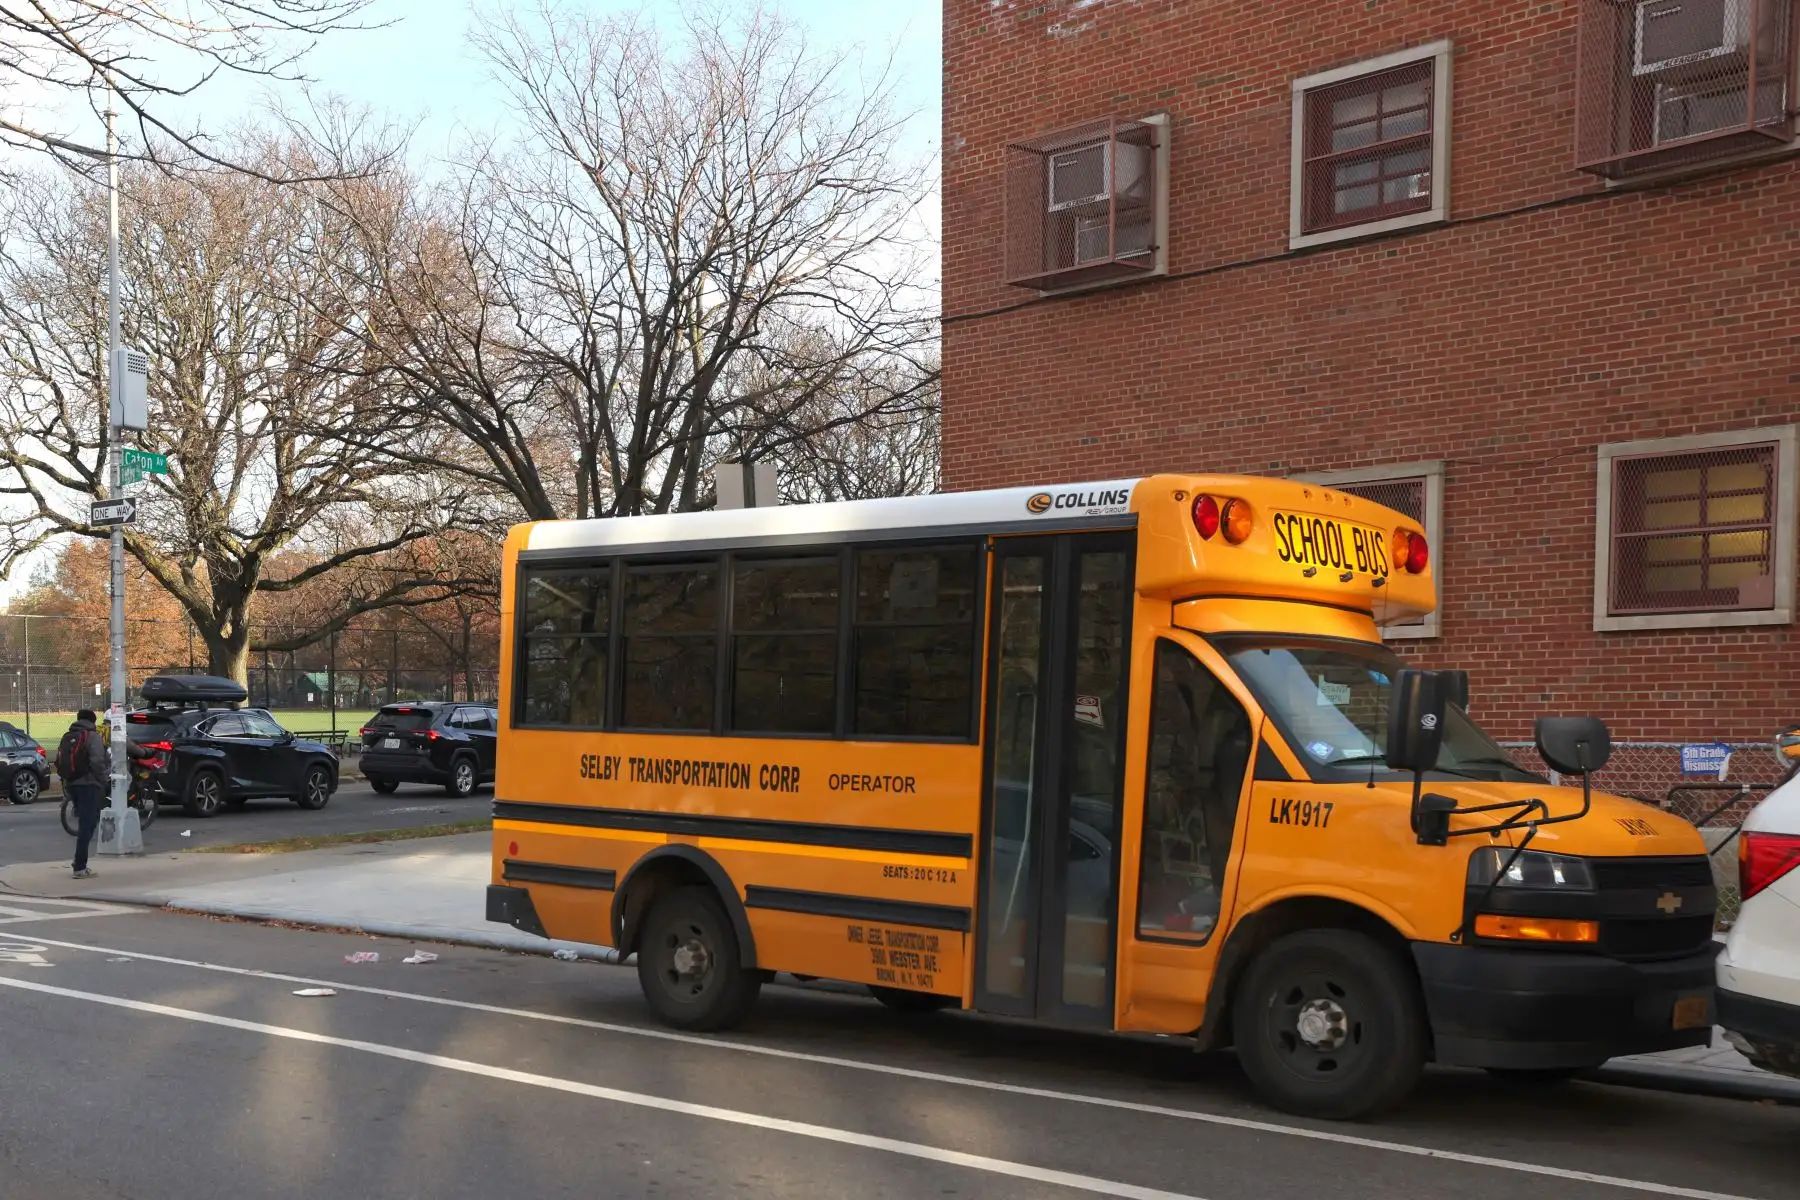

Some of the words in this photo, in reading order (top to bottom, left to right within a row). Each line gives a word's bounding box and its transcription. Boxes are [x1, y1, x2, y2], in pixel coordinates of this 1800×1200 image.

[125, 451, 153, 470] Caton
[1055, 489, 1129, 509] COLLINS
[94, 507, 109, 520] ONE
[116, 505, 131, 517] WAY
[1273, 512, 1353, 571] SCHOOL
[1353, 526, 1389, 578] BUS
[1683, 747, 1698, 758] 5th
[1700, 747, 1725, 758] Grade
[580, 753, 621, 781] SELBY
[629, 757, 750, 789] TRANSPORTATION
[759, 764, 800, 793] CORP.
[828, 773, 916, 794] OPERATOR
[1269, 797, 1334, 828] LK1917
[889, 949, 921, 969] WEBSTER
